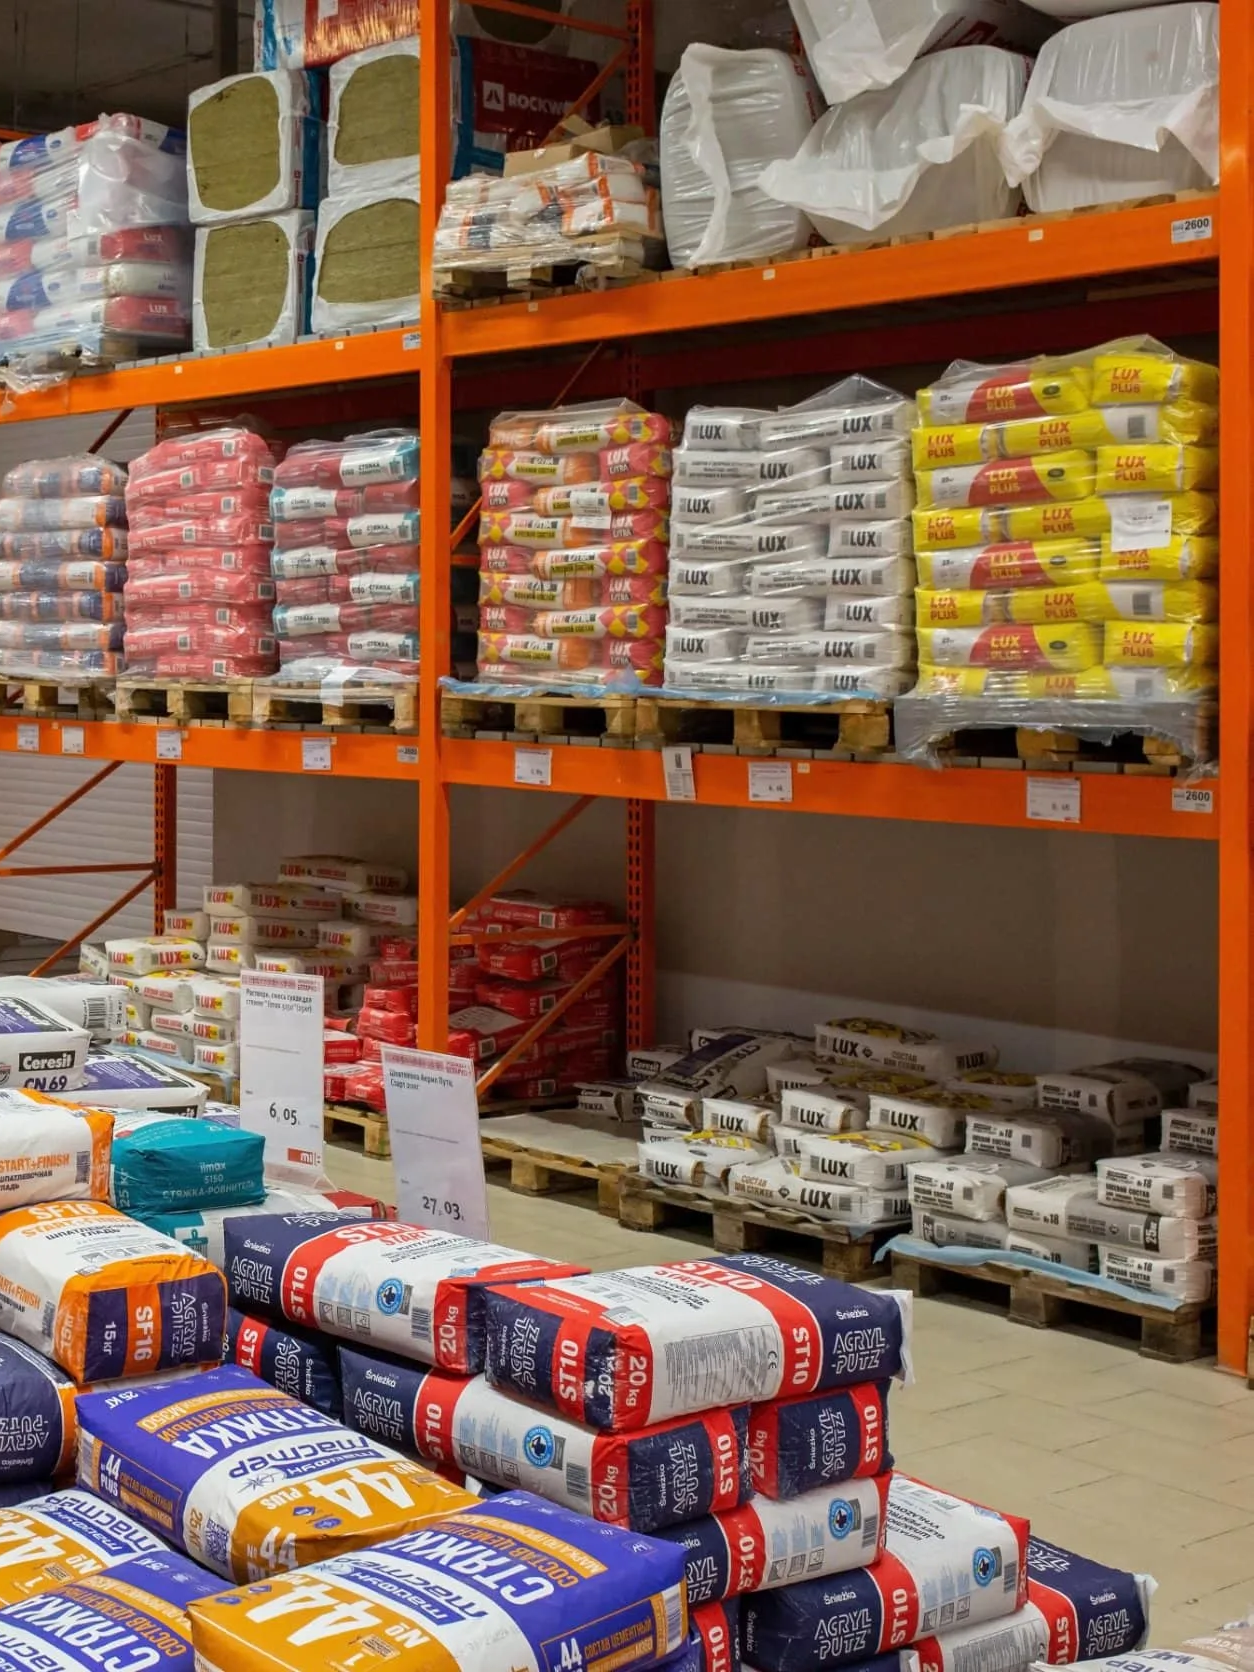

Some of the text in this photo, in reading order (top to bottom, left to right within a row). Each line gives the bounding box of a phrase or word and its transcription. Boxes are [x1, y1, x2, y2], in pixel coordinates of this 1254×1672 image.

[1183, 218, 1211, 231] 2600
[1112, 367, 1142, 382] LUX
[1111, 381, 1142, 394] PLUS
[699, 425, 722, 439] LUX
[843, 416, 872, 432] LUX
[1039, 422, 1070, 435] LUX
[1039, 435, 1071, 447] PLUS
[607, 449, 630, 463] LUX
[851, 454, 877, 470] LUX
[1116, 456, 1147, 468] LUX
[1115, 469, 1146, 482] PLUS
[609, 578, 631, 592] LUX
[832, 569, 862, 585] LUX
[824, 641, 854, 658] LUX
[1185, 791, 1211, 802] 2600
[218, 922, 234, 935] LUX
[265, 925, 287, 938] LUX
[112, 952, 127, 964] LUX
[159, 951, 182, 965] LUX
[832, 1038, 858, 1057] LUX
[22, 1053, 73, 1070] Ceresit
[23, 1075, 68, 1090] CN 69
[800, 1108, 824, 1127] LUX
[890, 1110, 918, 1130] LUX
[821, 1157, 847, 1177] LUX
[800, 1187, 832, 1209] LUX
[28, 1202, 97, 1219] SF16
[335, 1221, 415, 1245] ST10
[243, 1239, 271, 1255] Śnieżka
[231, 1256, 274, 1286] ACRYL
[291, 1266, 308, 1321] ST10
[134, 1305, 153, 1361] SF16
[438, 1328, 457, 1355] 20
[832, 1326, 886, 1355] ACRYL
[792, 1326, 810, 1386] ST10
[560, 1339, 580, 1403] ST10
[353, 1388, 405, 1418] ACRYL
[864, 1403, 878, 1463] ST10
[718, 1433, 735, 1495] ST10
[599, 1482, 618, 1517] 20
[815, 1608, 873, 1641] ACRYL
[889, 1587, 908, 1648] ST10
